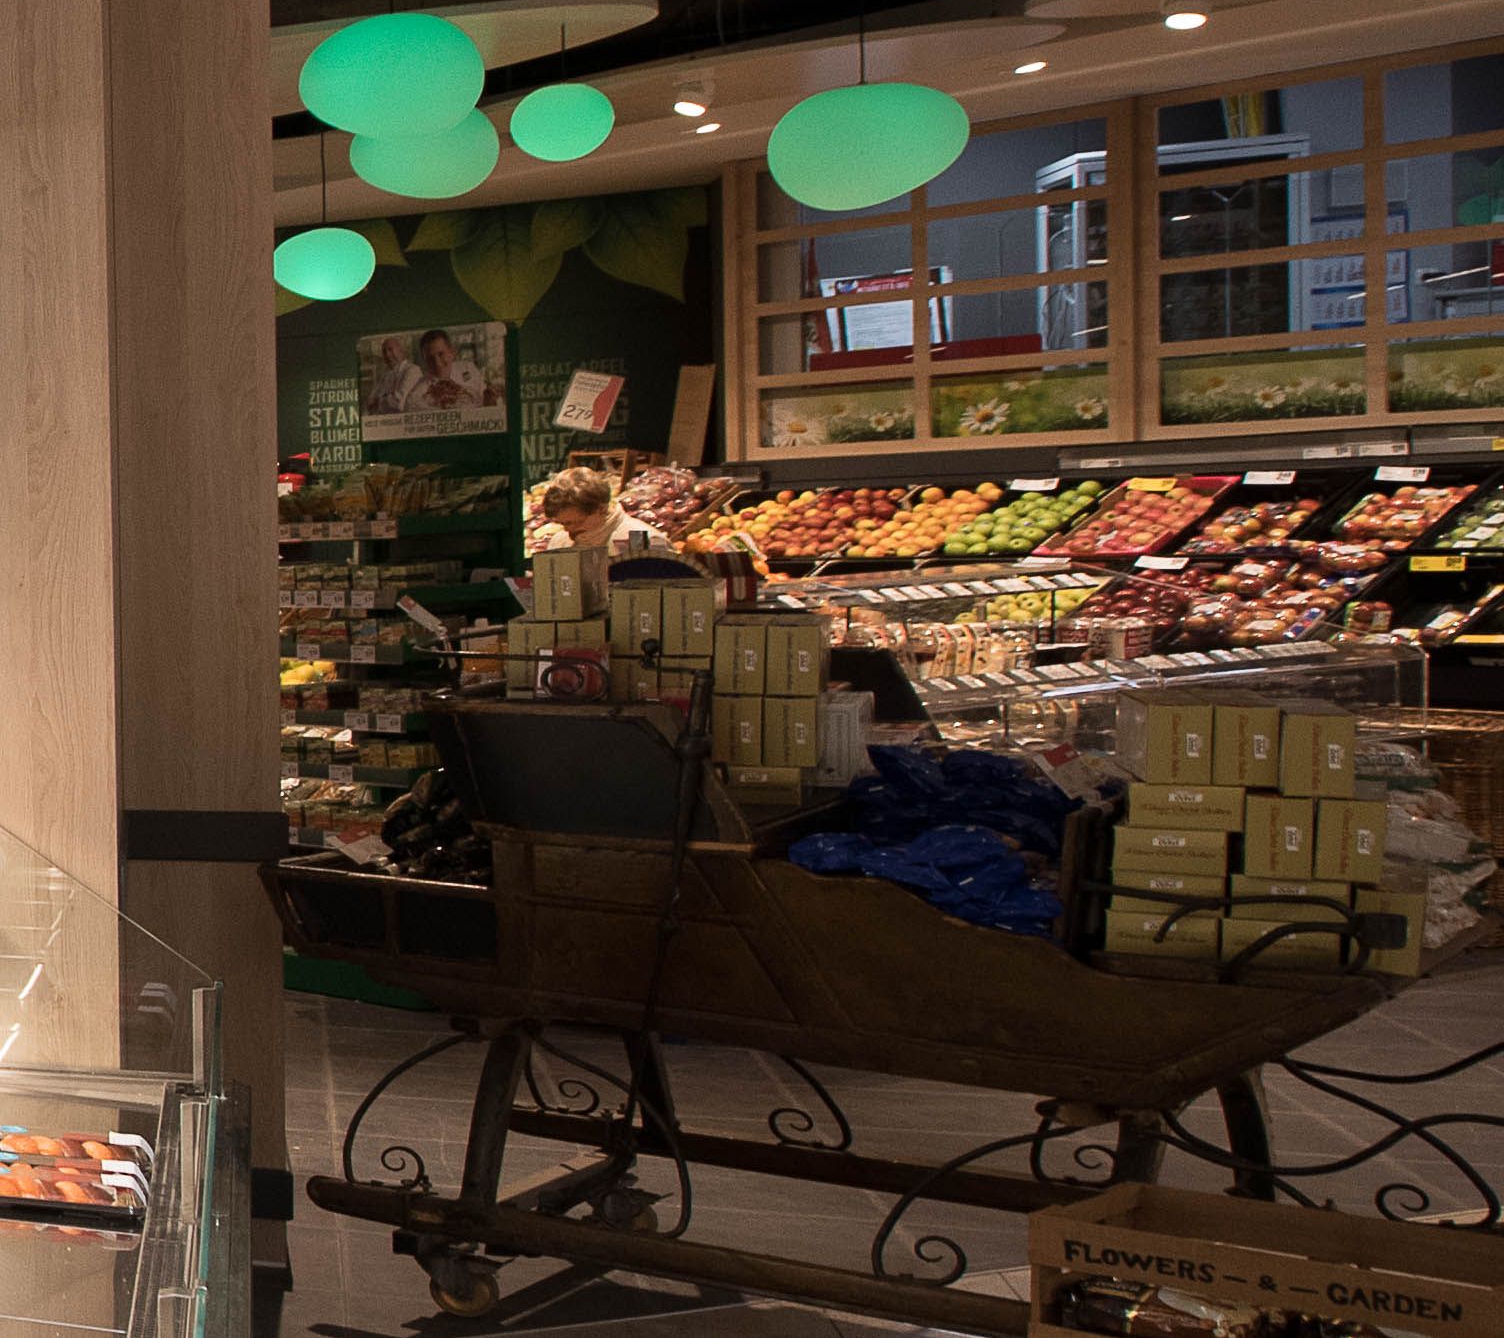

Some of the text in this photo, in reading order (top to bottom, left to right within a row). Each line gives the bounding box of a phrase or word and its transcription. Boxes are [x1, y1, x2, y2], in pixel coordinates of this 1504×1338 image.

[1063, 1239, 1464, 1322] FLOWERS & GARDEN
